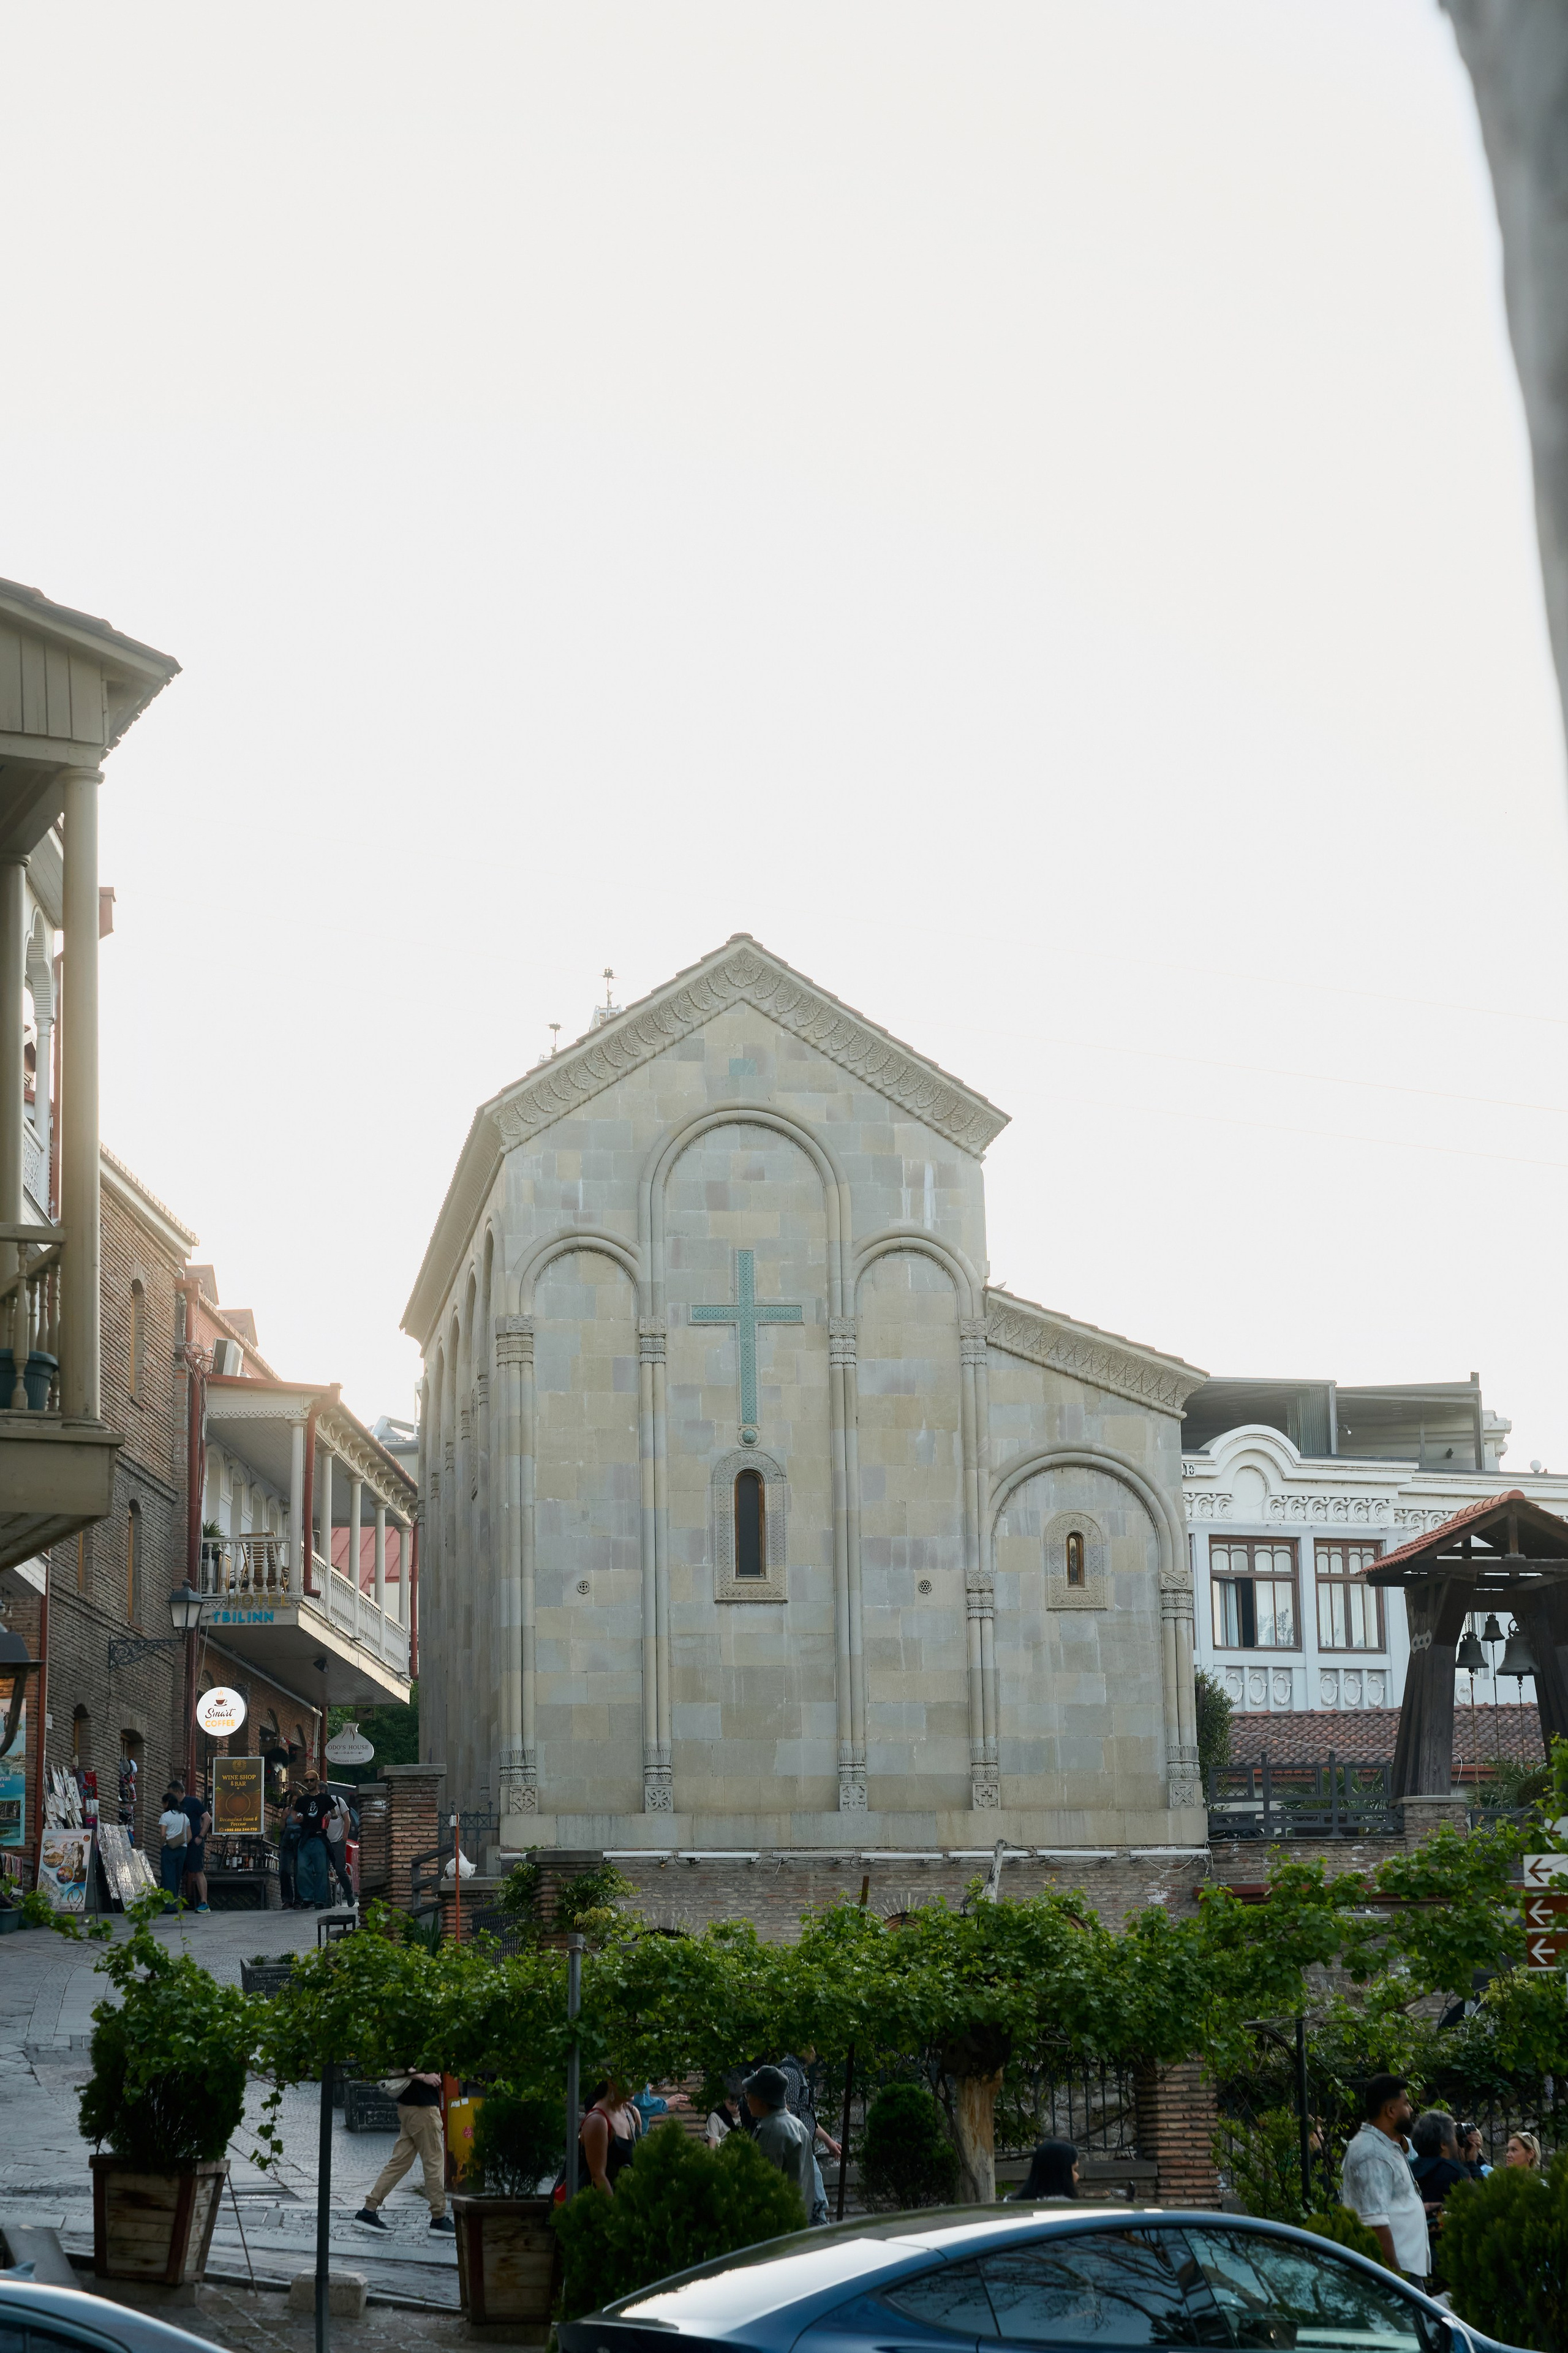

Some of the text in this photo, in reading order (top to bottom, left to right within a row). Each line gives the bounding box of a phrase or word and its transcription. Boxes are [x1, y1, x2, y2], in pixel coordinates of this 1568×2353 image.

[226, 1594, 291, 1608] HOTEL
[212, 1611, 274, 1623] TBILINN
[205, 1708, 236, 1719] Smart
